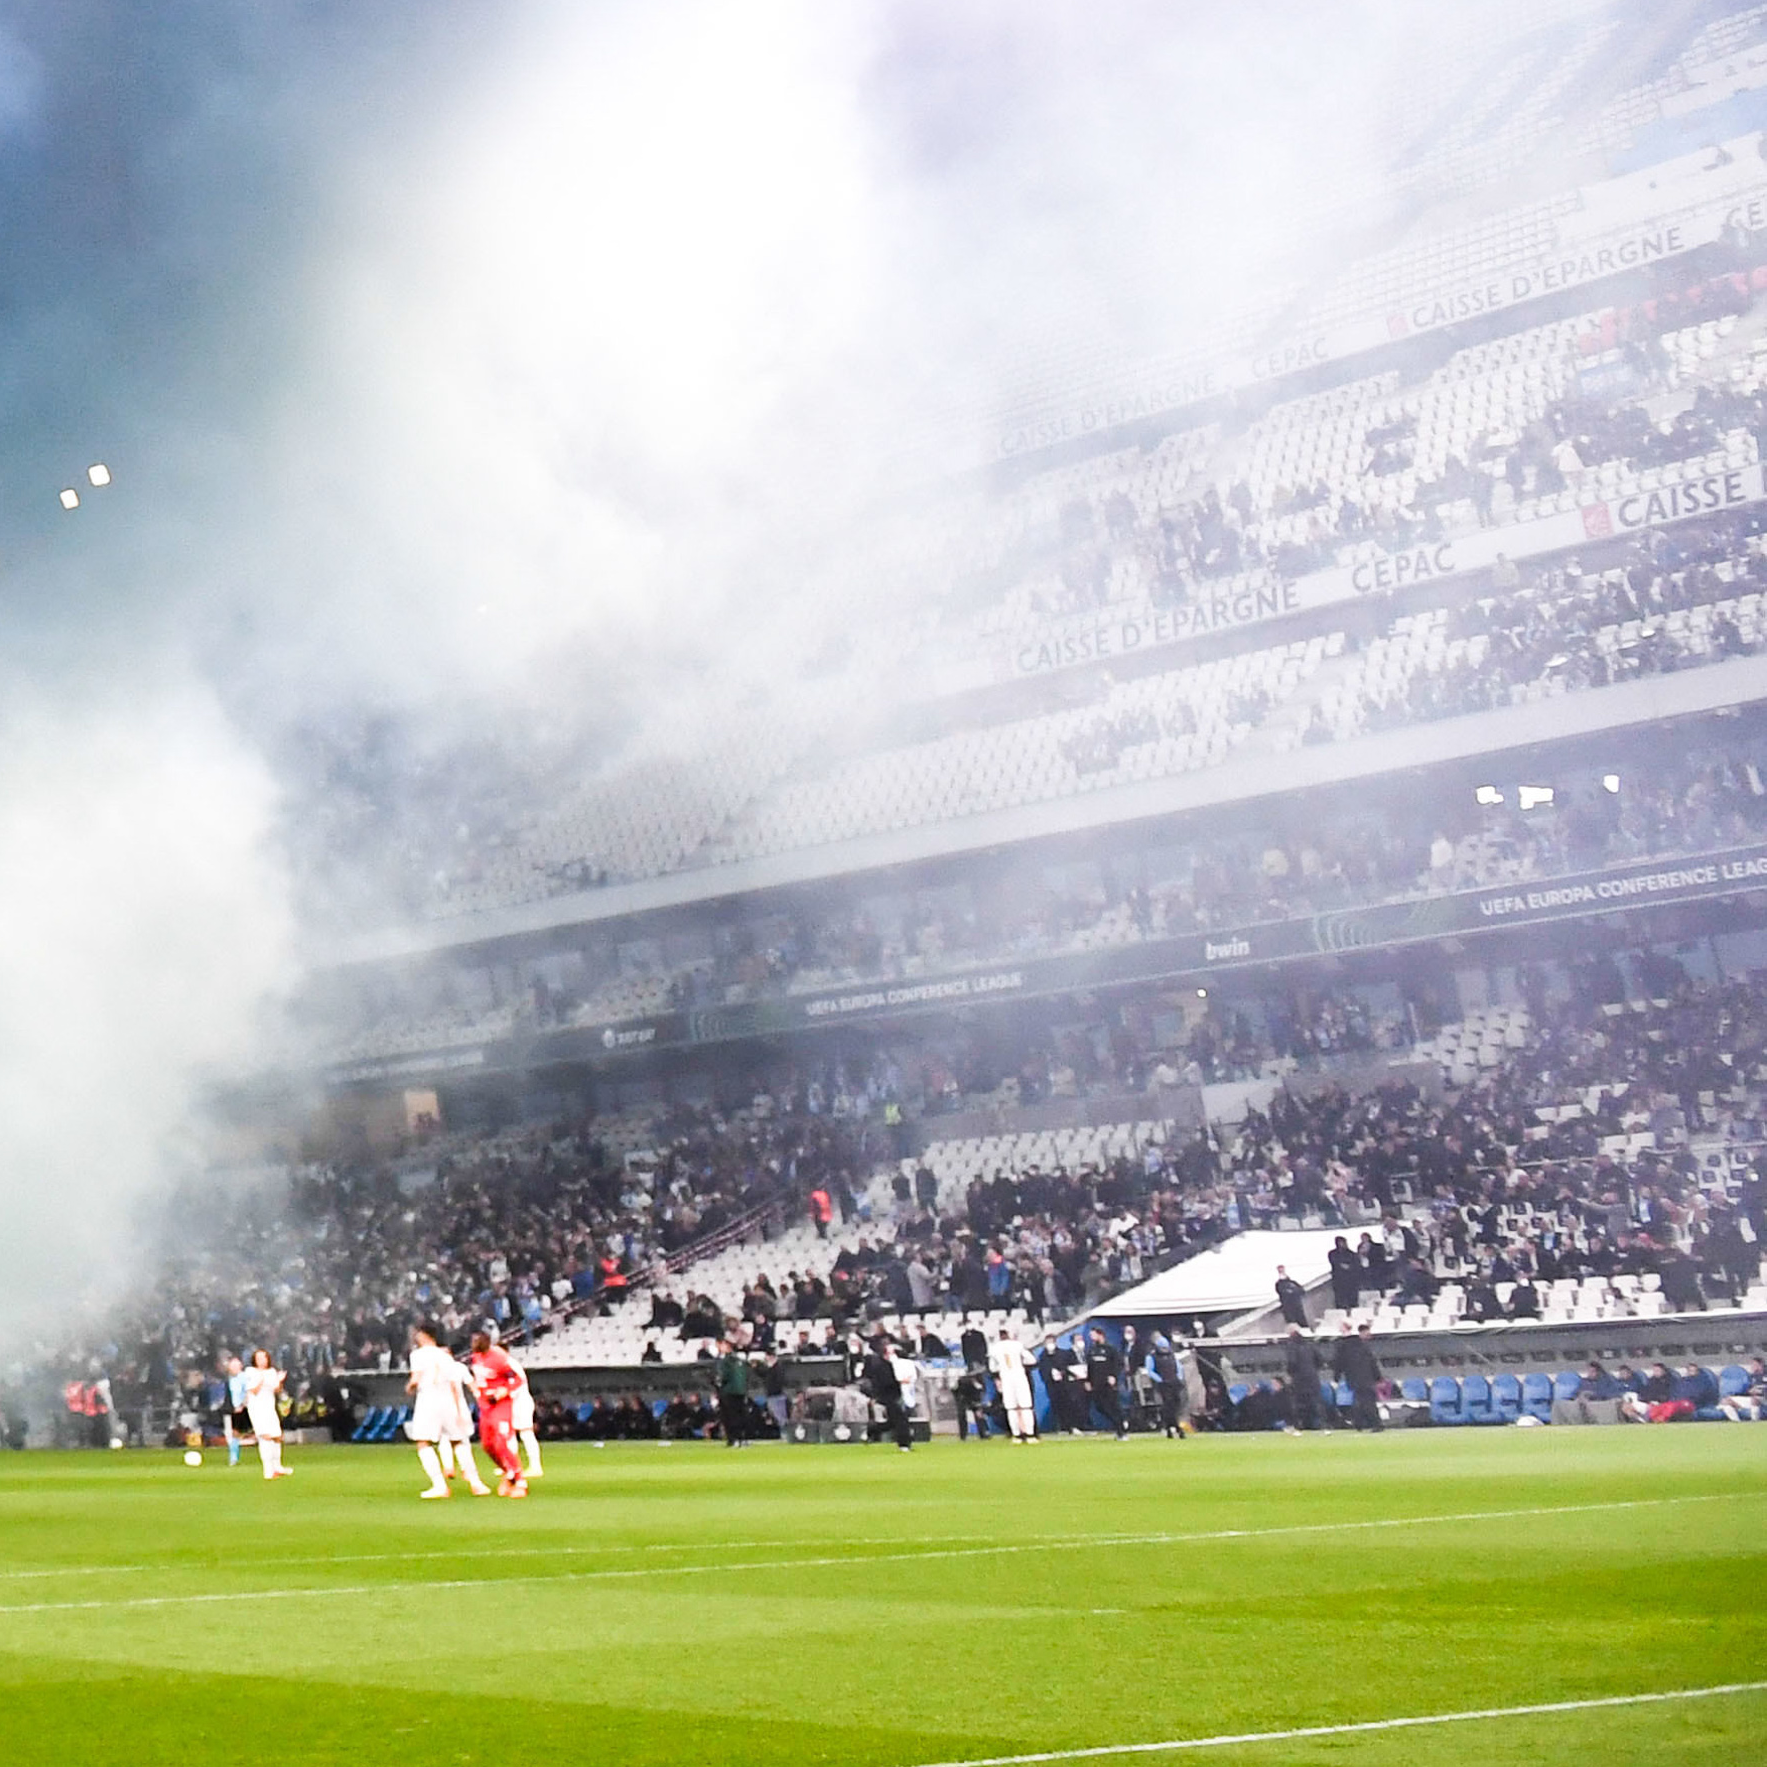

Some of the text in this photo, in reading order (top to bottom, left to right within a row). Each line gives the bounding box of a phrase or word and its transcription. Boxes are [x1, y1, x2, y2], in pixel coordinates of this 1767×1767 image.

[1413, 283, 1503, 329] CAISSE
[1513, 226, 1685, 299] D'EPARGNE
[1252, 336, 1330, 379] CEPAC
[1618, 472, 1747, 528] CAISSE
[1016, 542, 1456, 674] CAISSE D'EPARGNE CEPAC
[1480, 897, 1527, 917] UEFA
[1527, 885, 1597, 911] EUROPA
[1597, 865, 1719, 900] CONFERENCE
